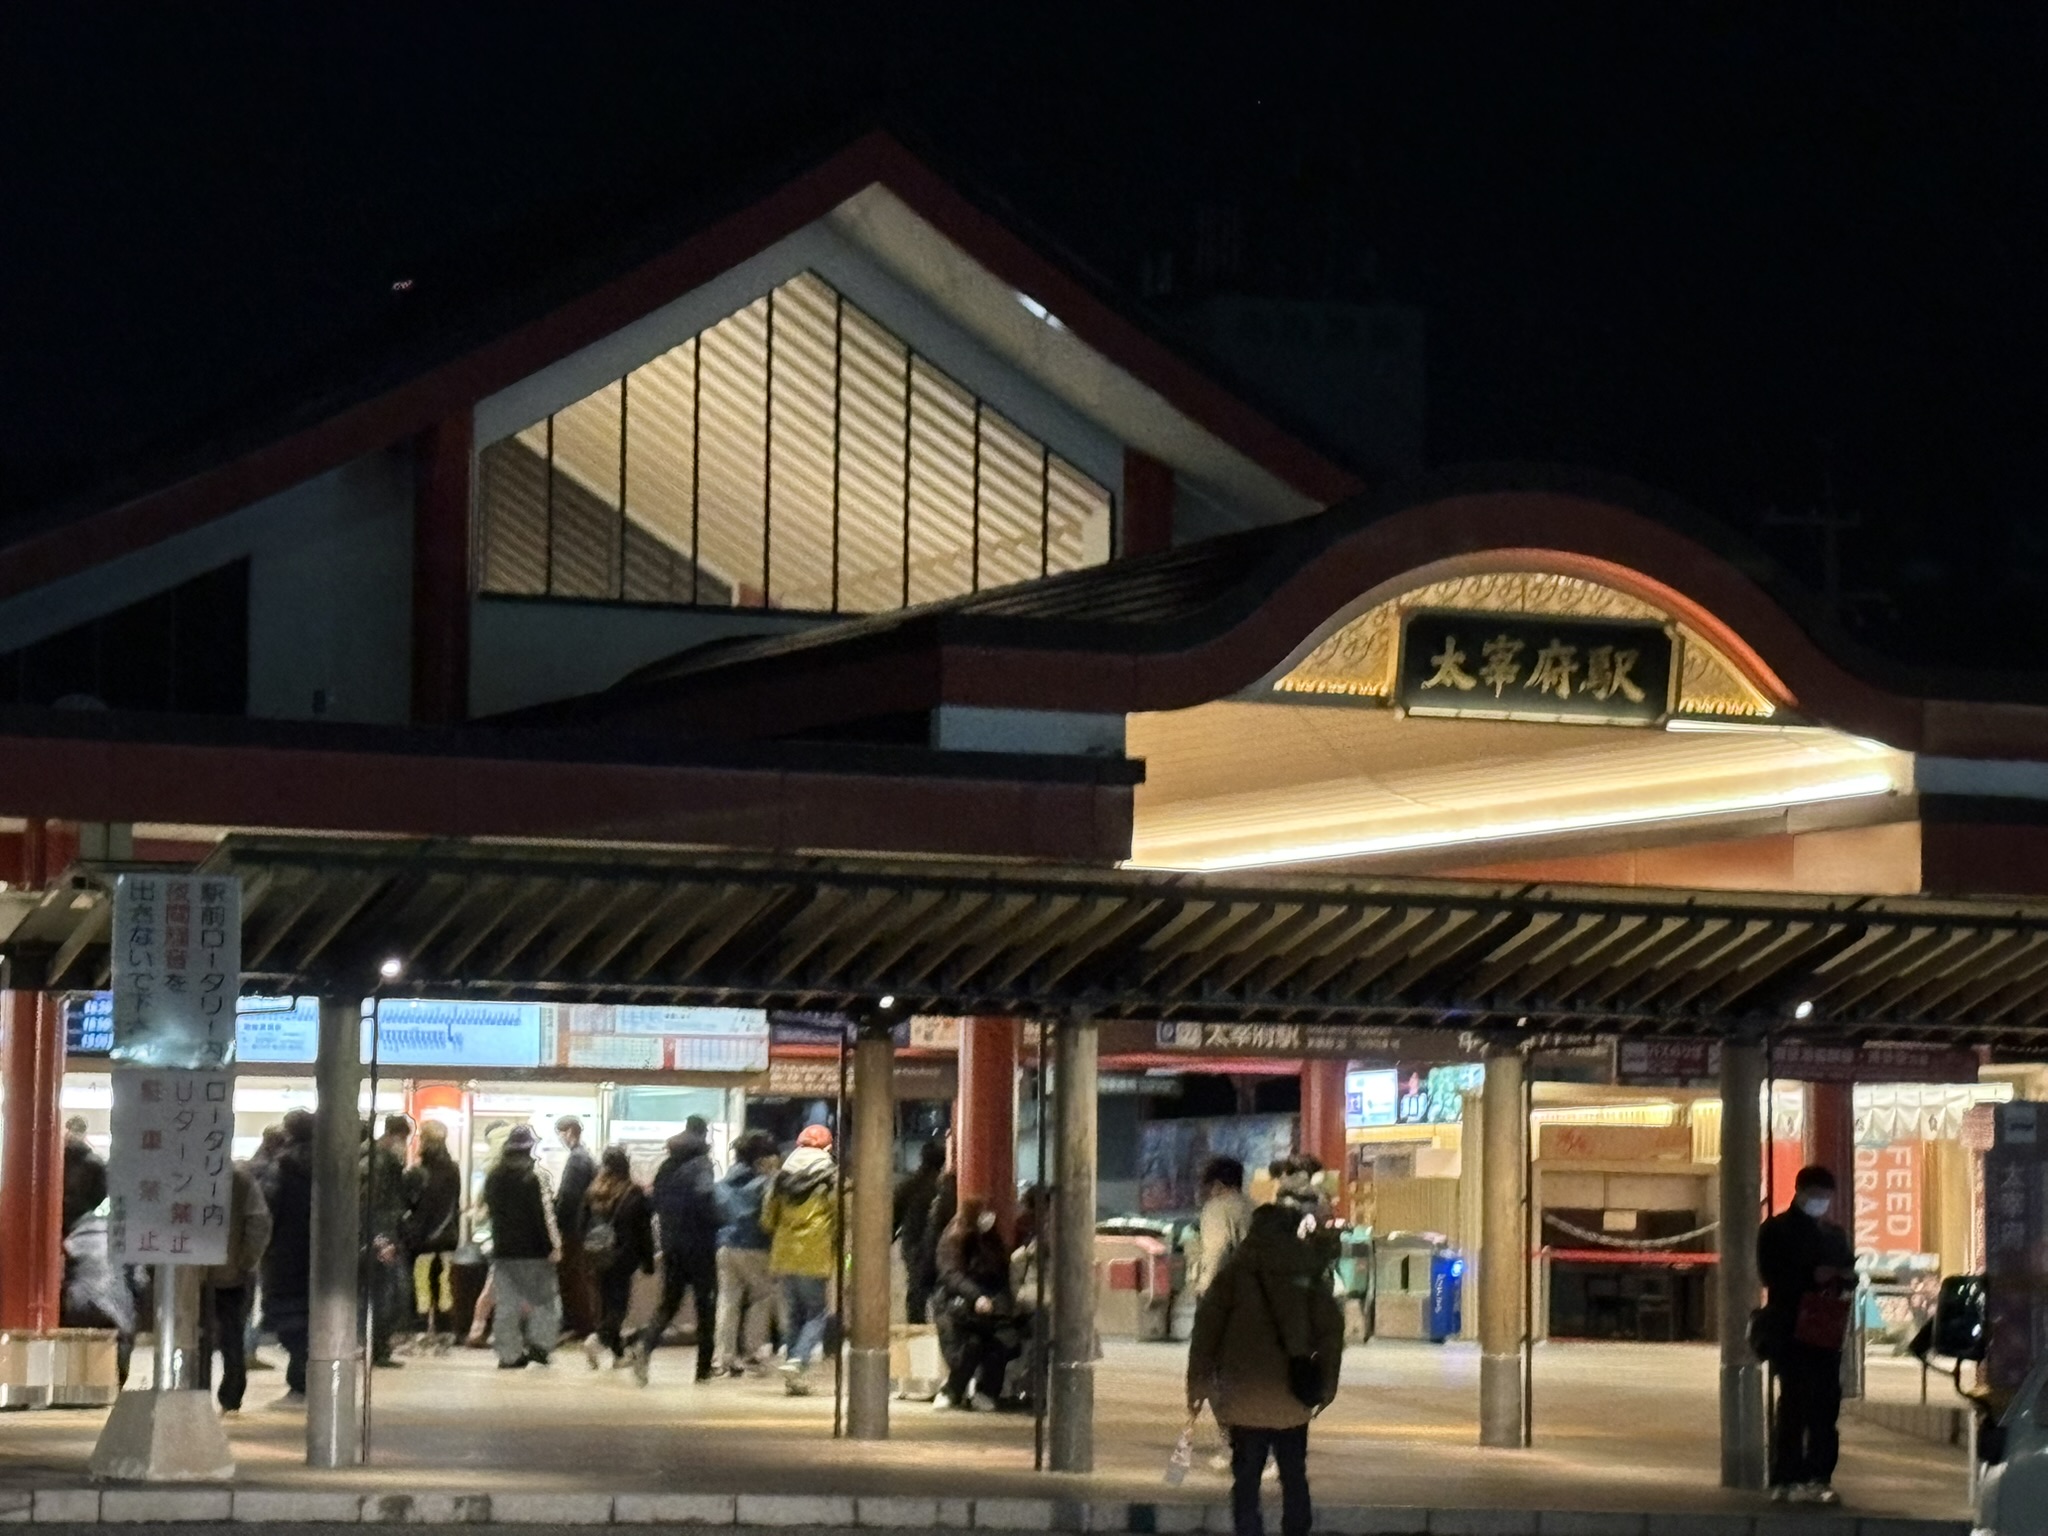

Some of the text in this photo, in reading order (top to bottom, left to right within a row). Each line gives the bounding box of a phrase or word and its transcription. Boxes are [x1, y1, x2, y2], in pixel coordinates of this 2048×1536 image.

[1421, 634, 1646, 703] 太宰府駅
[202, 1081, 227, 1227] ロータリー内
[1886, 1145, 1912, 1236] FEED
